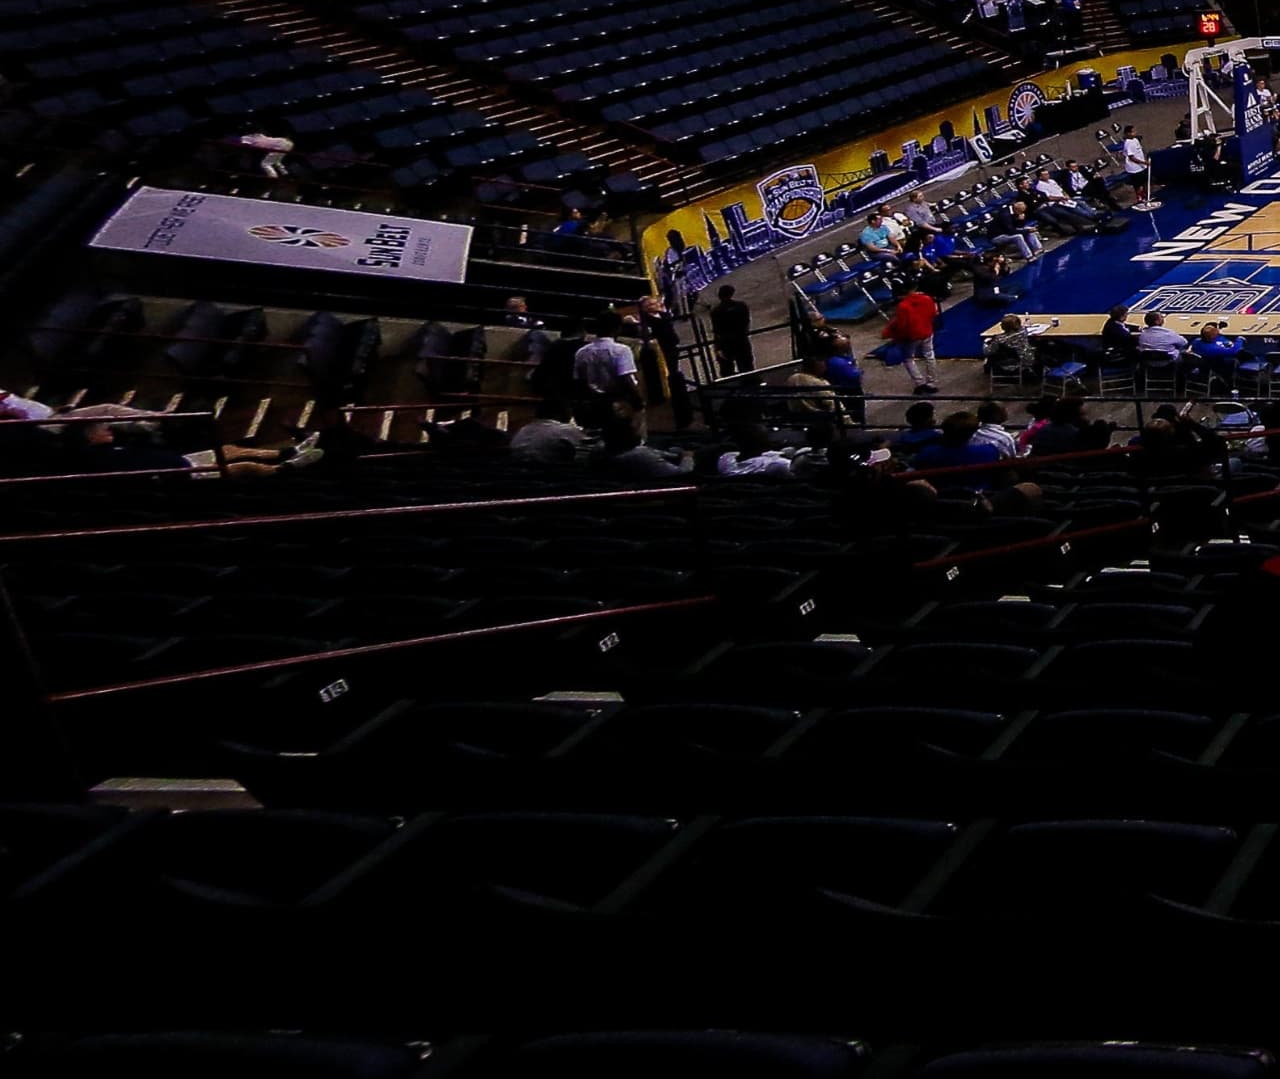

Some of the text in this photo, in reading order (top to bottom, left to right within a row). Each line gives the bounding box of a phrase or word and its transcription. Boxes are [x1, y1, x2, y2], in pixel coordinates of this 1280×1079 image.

[1203, 22, 1216, 32] 28
[357, 223, 412, 268] SUN BELT
[1130, 202, 1259, 263] NEW
